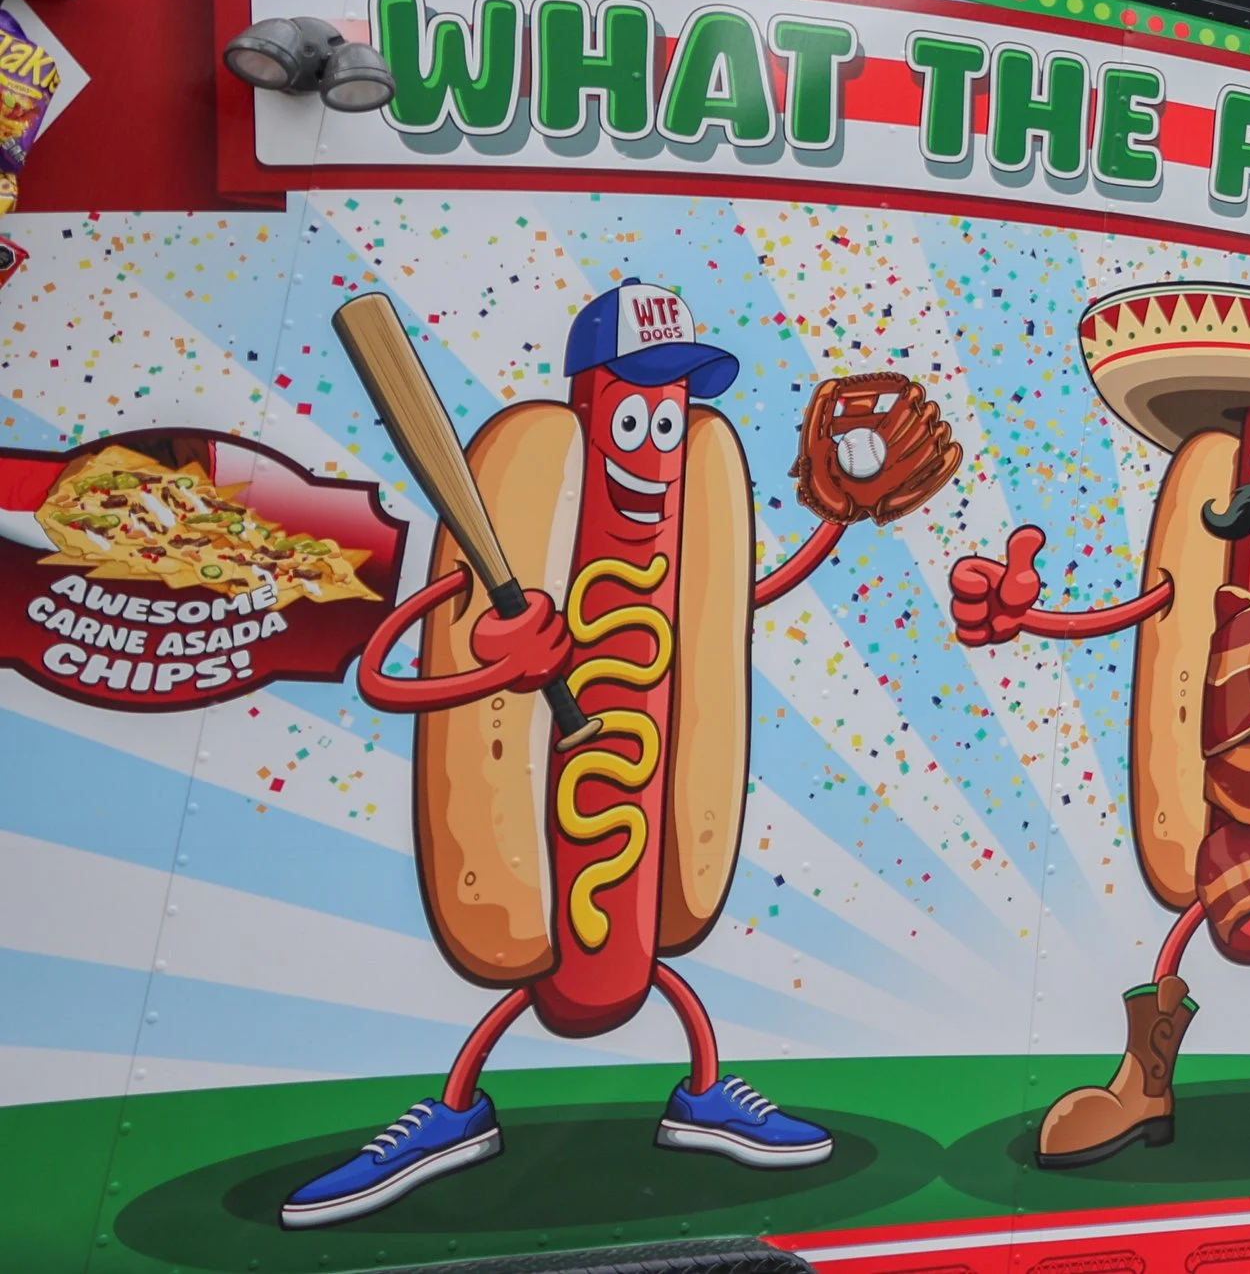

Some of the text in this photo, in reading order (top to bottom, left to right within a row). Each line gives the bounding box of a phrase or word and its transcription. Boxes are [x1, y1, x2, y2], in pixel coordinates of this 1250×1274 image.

[906, 30, 1168, 194] THE
[633, 297, 679, 328] WTF
[640, 327, 683, 342] DOGS
[51, 574, 277, 625] AWESOME
[27, 596, 288, 658] CARNE ASADA
[42, 642, 254, 693] CHIPS!
